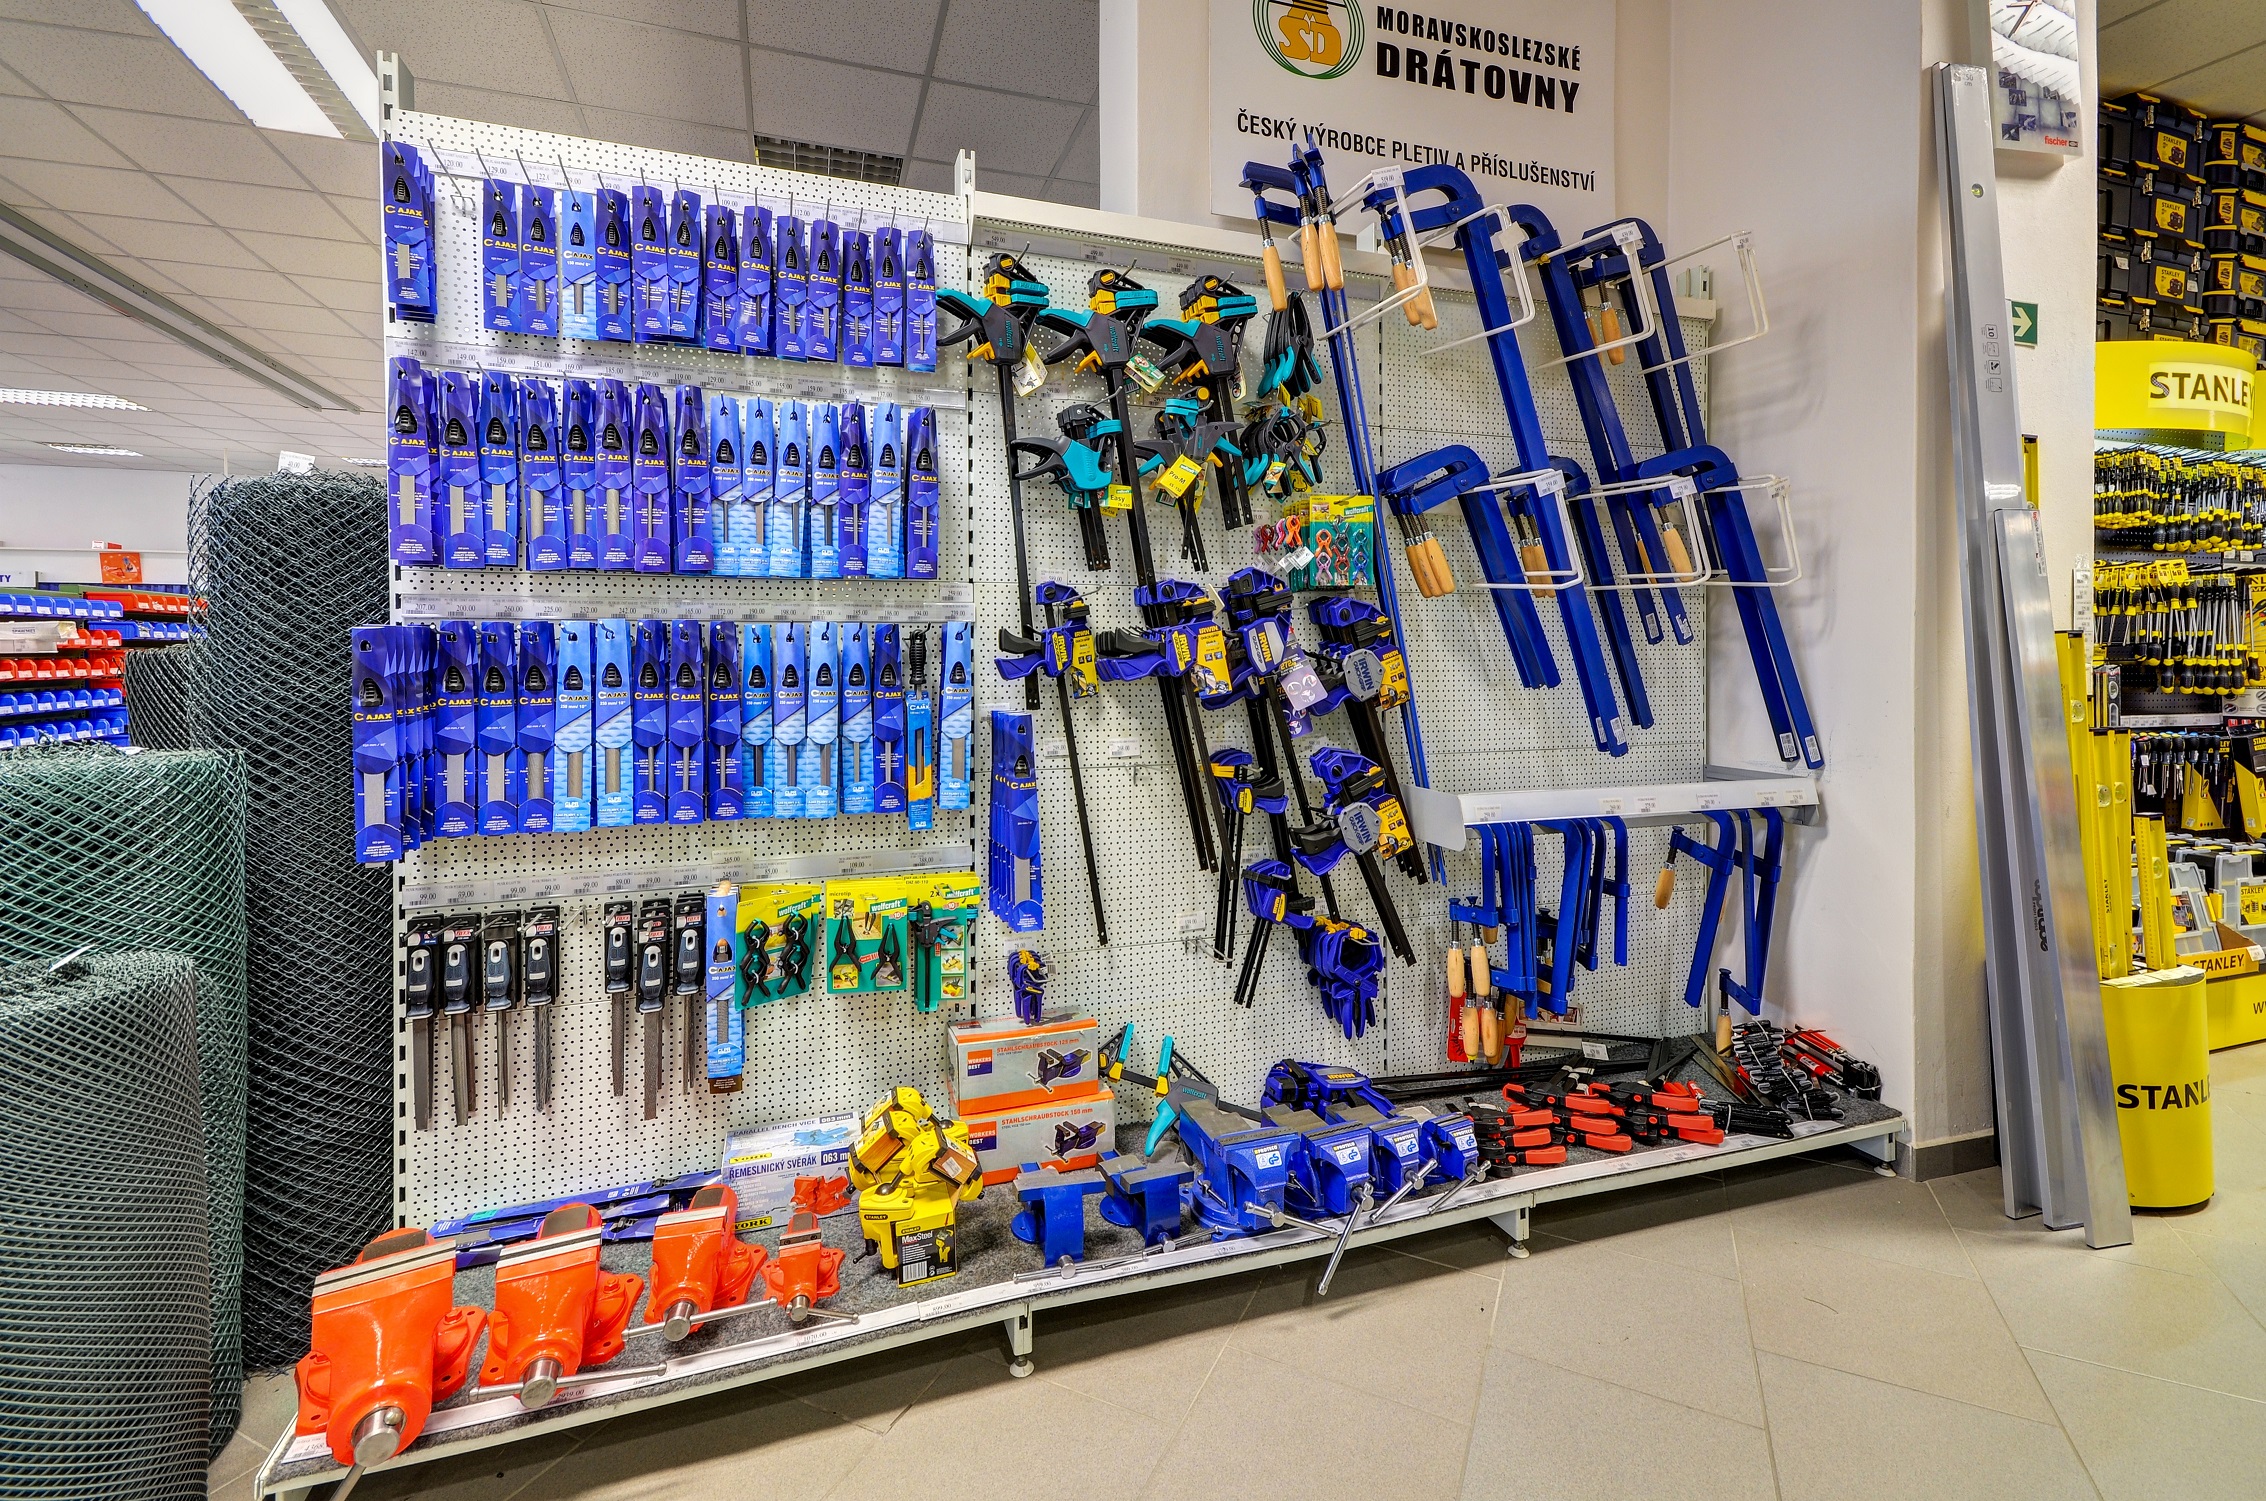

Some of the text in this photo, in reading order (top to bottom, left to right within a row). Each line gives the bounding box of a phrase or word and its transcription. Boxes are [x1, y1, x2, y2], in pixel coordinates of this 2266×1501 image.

[1376, 6, 1581, 71] MORAVSKOSLEZSKÉ
[1376, 41, 1580, 114] DRÁTOVNY
[2044, 136, 2068, 147] fischer
[1237, 108, 1596, 191] ČESKÝ VÝROBCE PLETIV A PŘÍSLUŠENSTVÍ
[2161, 269, 2180, 278] STANLEY
[2150, 372, 2256, 411] STANLEY
[1110, 495, 1125, 503] Easy
[1179, 634, 1191, 663] IRWIN
[1258, 632, 1272, 662] IRWIN
[1358, 658, 1374, 691] IRWIN
[366, 713, 392, 721] AJAX
[1354, 812, 1373, 843] IRWIN
[2241, 887, 2264, 895] STANLEY
[872, 901, 901, 912] wolfcraft
[2192, 954, 2245, 971] STANLEY
[996, 1040, 1057, 1053] STAHLSCHRAUBSTOCK
[1002, 1110, 1069, 1125] STAHLSCHRAUBSTOCK
[823, 1152, 837, 1163] 063
[729, 1156, 817, 1179] ŘEMESLNICKÝ SVĚRÁK
[735, 1219, 767, 1228] YORK
[902, 1231, 933, 1244] MaxSteel
